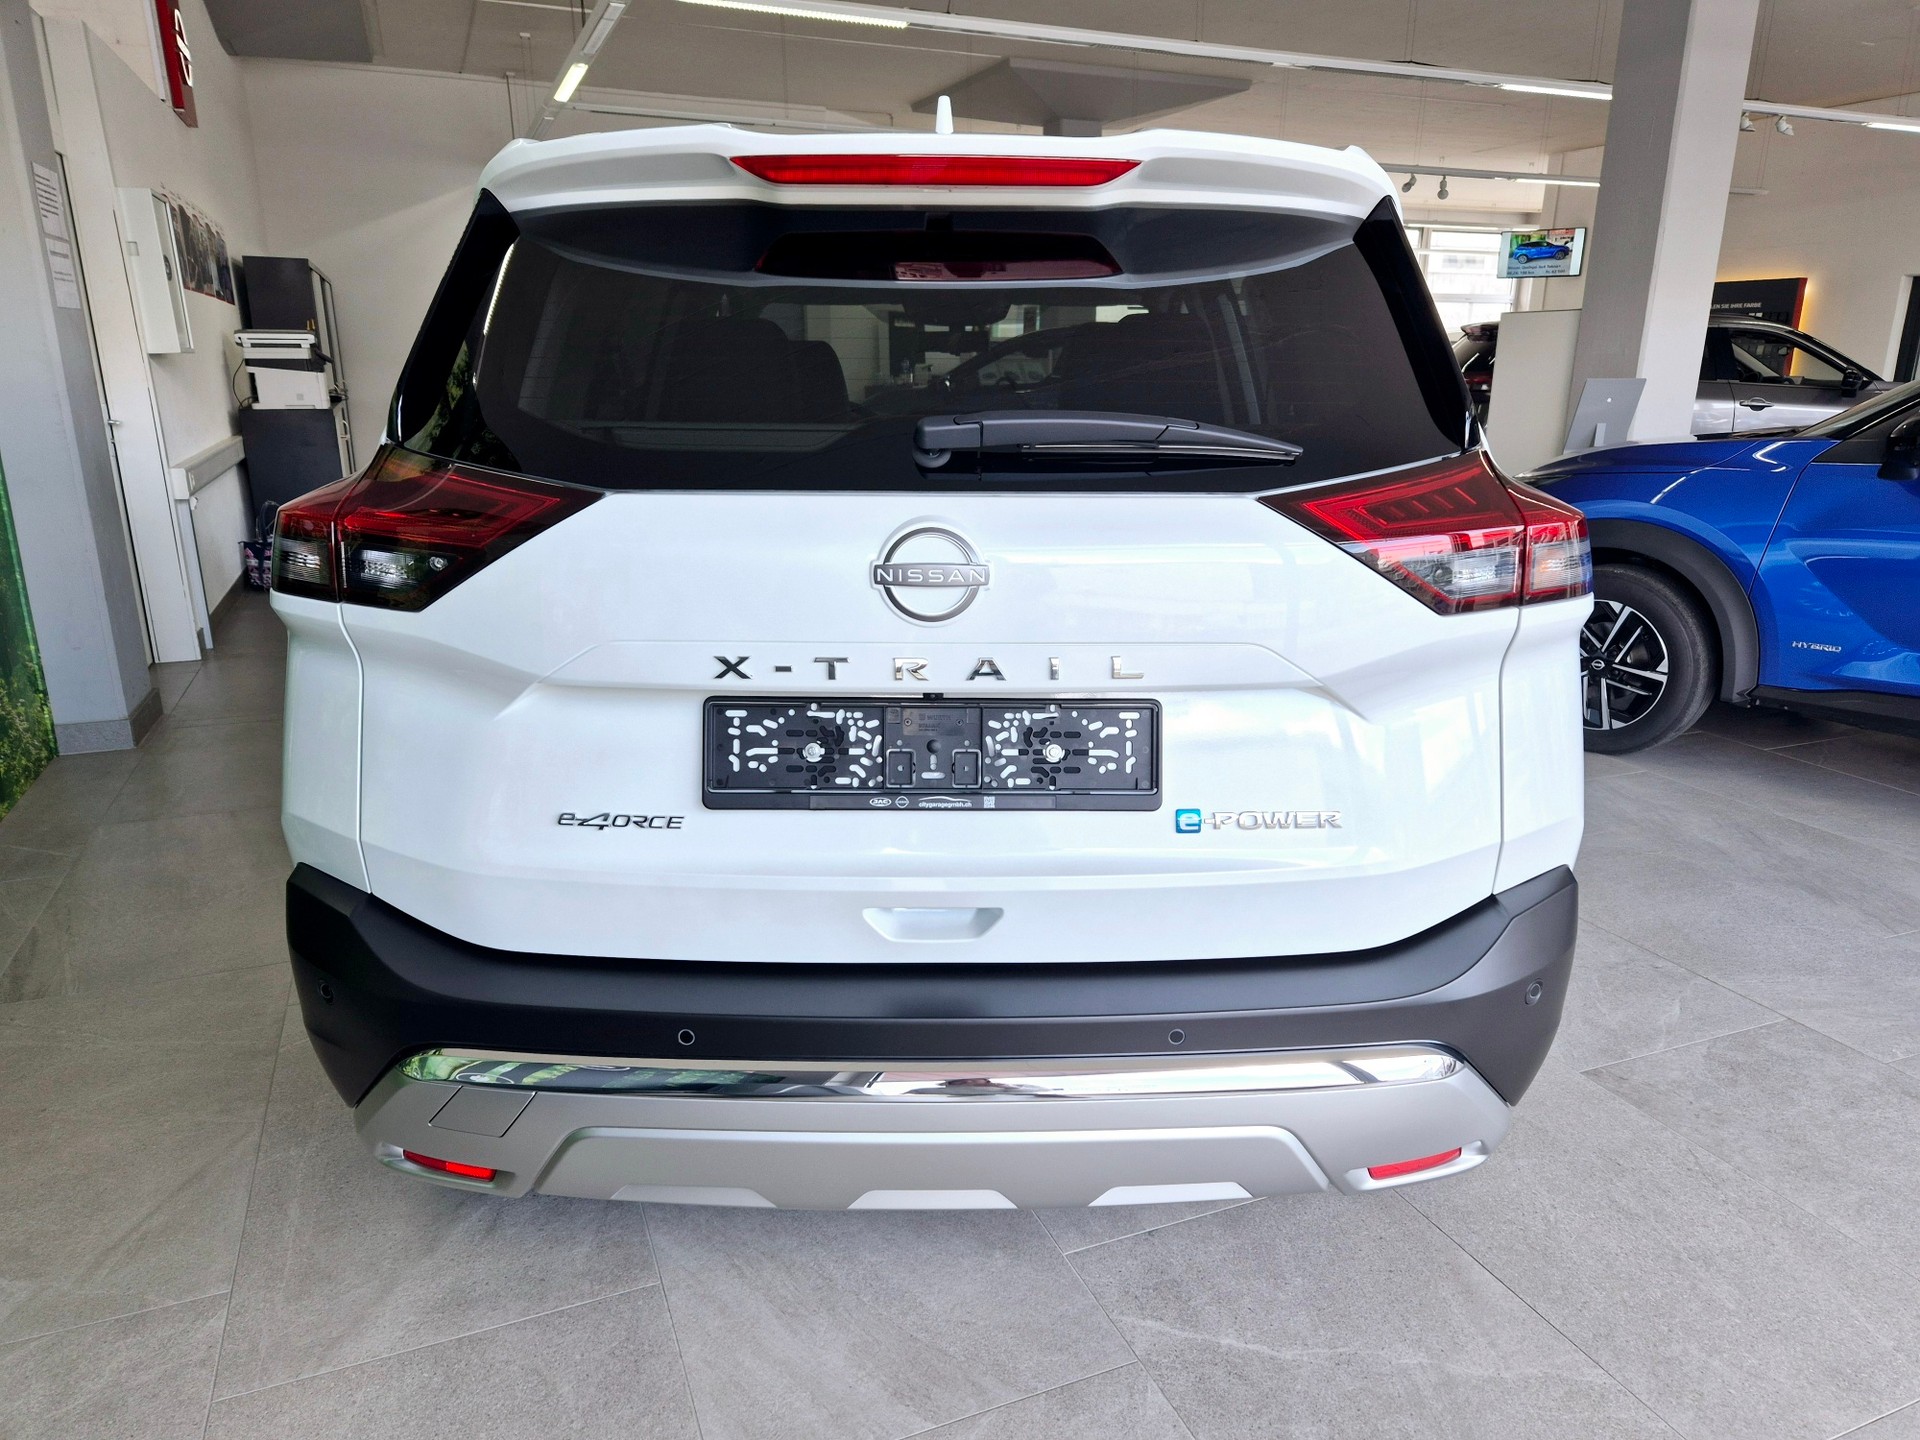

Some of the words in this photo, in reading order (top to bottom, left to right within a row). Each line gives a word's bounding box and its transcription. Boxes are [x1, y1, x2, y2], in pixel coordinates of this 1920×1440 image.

[876, 568, 985, 583] NISSAN
[1791, 640, 1842, 653] HYBRID
[713, 656, 1145, 681] X-TRAIL
[1175, 808, 1343, 834] e-POWER
